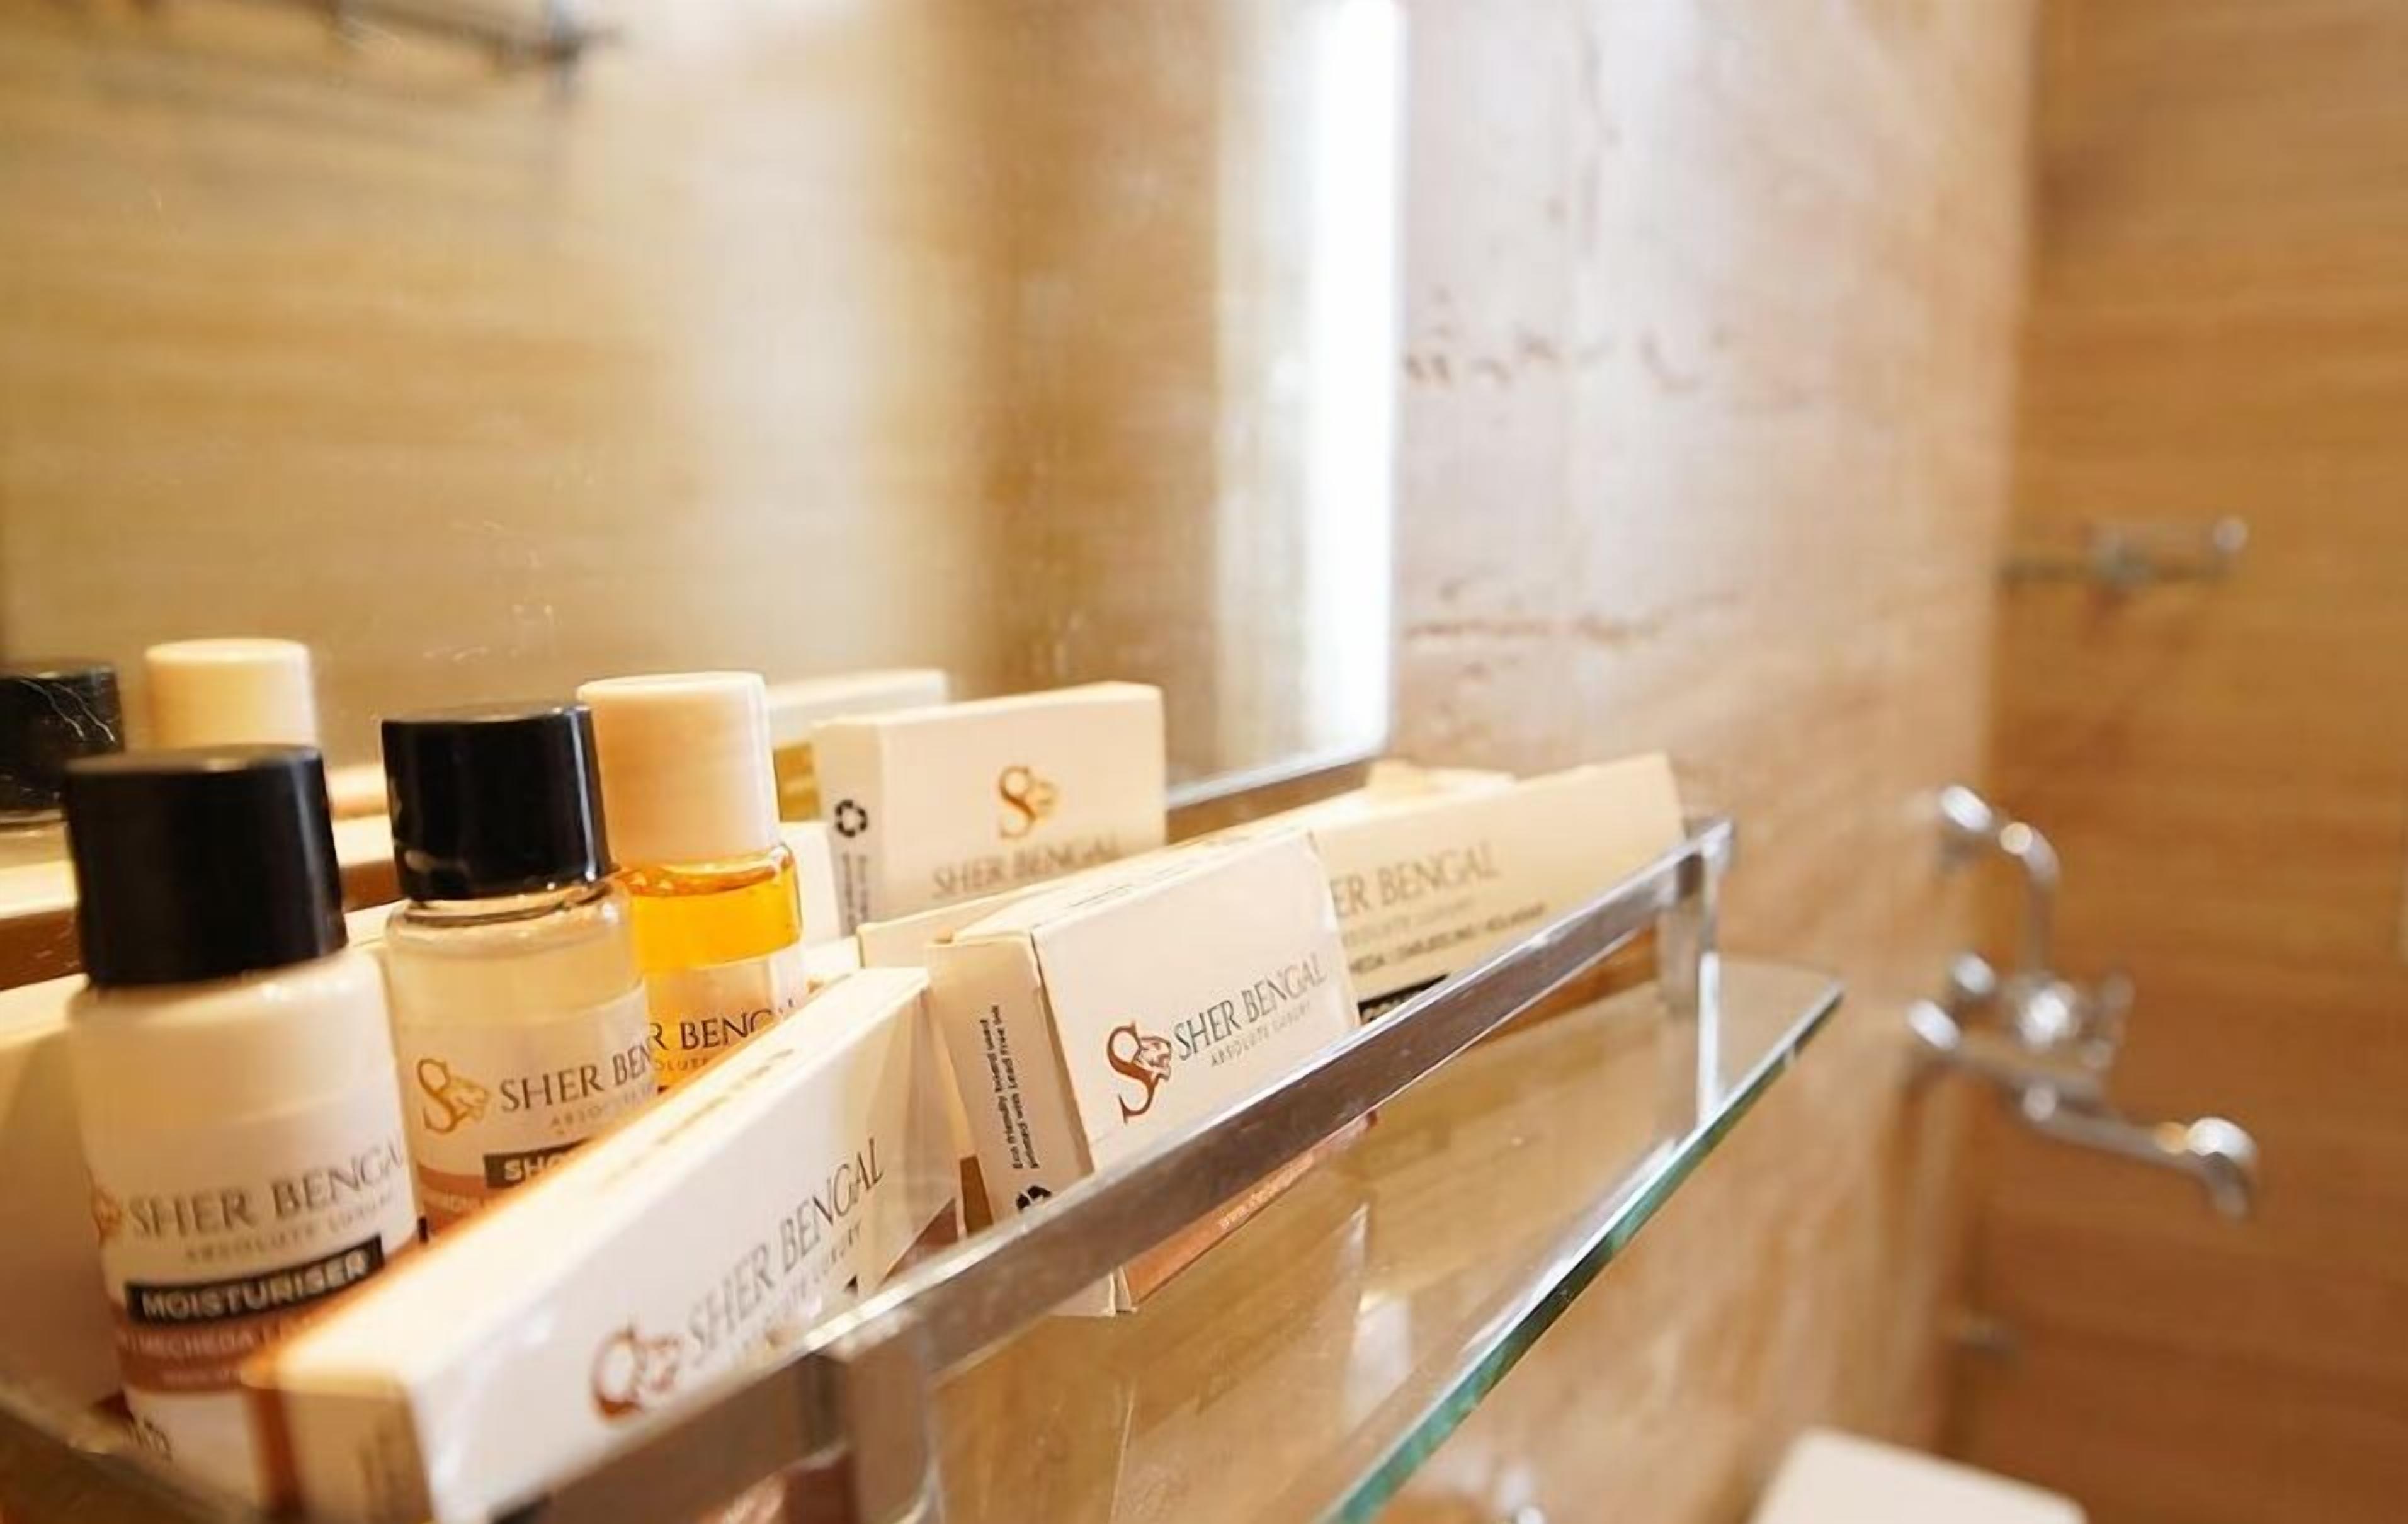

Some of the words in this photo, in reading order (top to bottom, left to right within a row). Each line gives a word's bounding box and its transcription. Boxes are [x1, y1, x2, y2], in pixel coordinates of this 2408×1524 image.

[1331, 876, 1372, 918] ER
[1376, 839, 1503, 907] BENGAL
[1174, 999, 1241, 1062] SHER
[1241, 952, 1327, 1023] BENGAL
[499, 1063, 605, 1113] SHER
[612, 1042, 651, 1087] BEN
[128, 1189, 259, 1239] SHER
[688, 1243, 776, 1364] SHER
[779, 1137, 884, 1273] BENGAL
[142, 1249, 370, 1320] MOISTURISER
